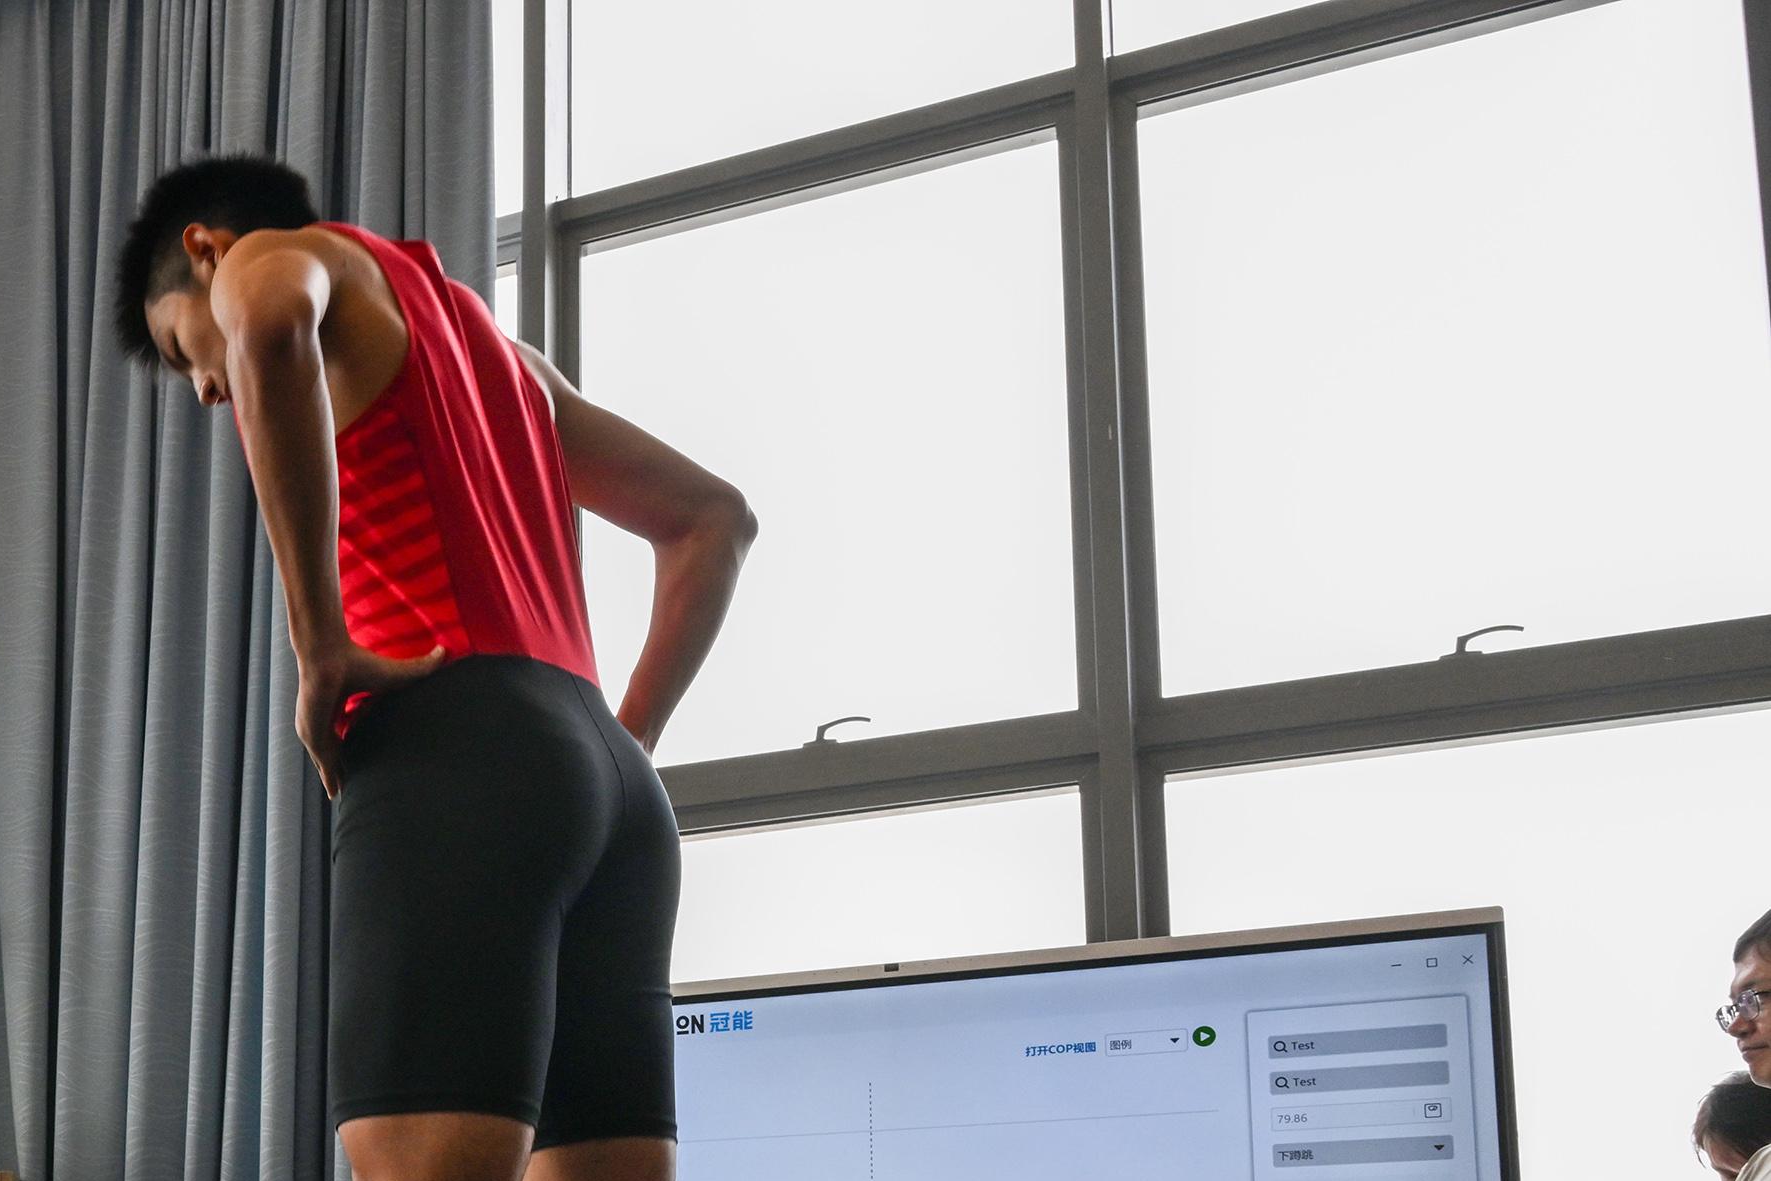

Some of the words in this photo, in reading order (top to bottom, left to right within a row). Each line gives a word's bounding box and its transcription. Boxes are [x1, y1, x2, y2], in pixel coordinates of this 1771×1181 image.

[710, 1010, 753, 1033] 冠能
[1026, 1042, 1097, 1057] 打开COP视图
[1109, 1040, 1132, 1051] 图例
[1291, 1041, 1315, 1051] Test
[1293, 1077, 1317, 1087] Test
[1278, 1113, 1308, 1124] 79.86
[1278, 1150, 1314, 1161] 下蹲跳
